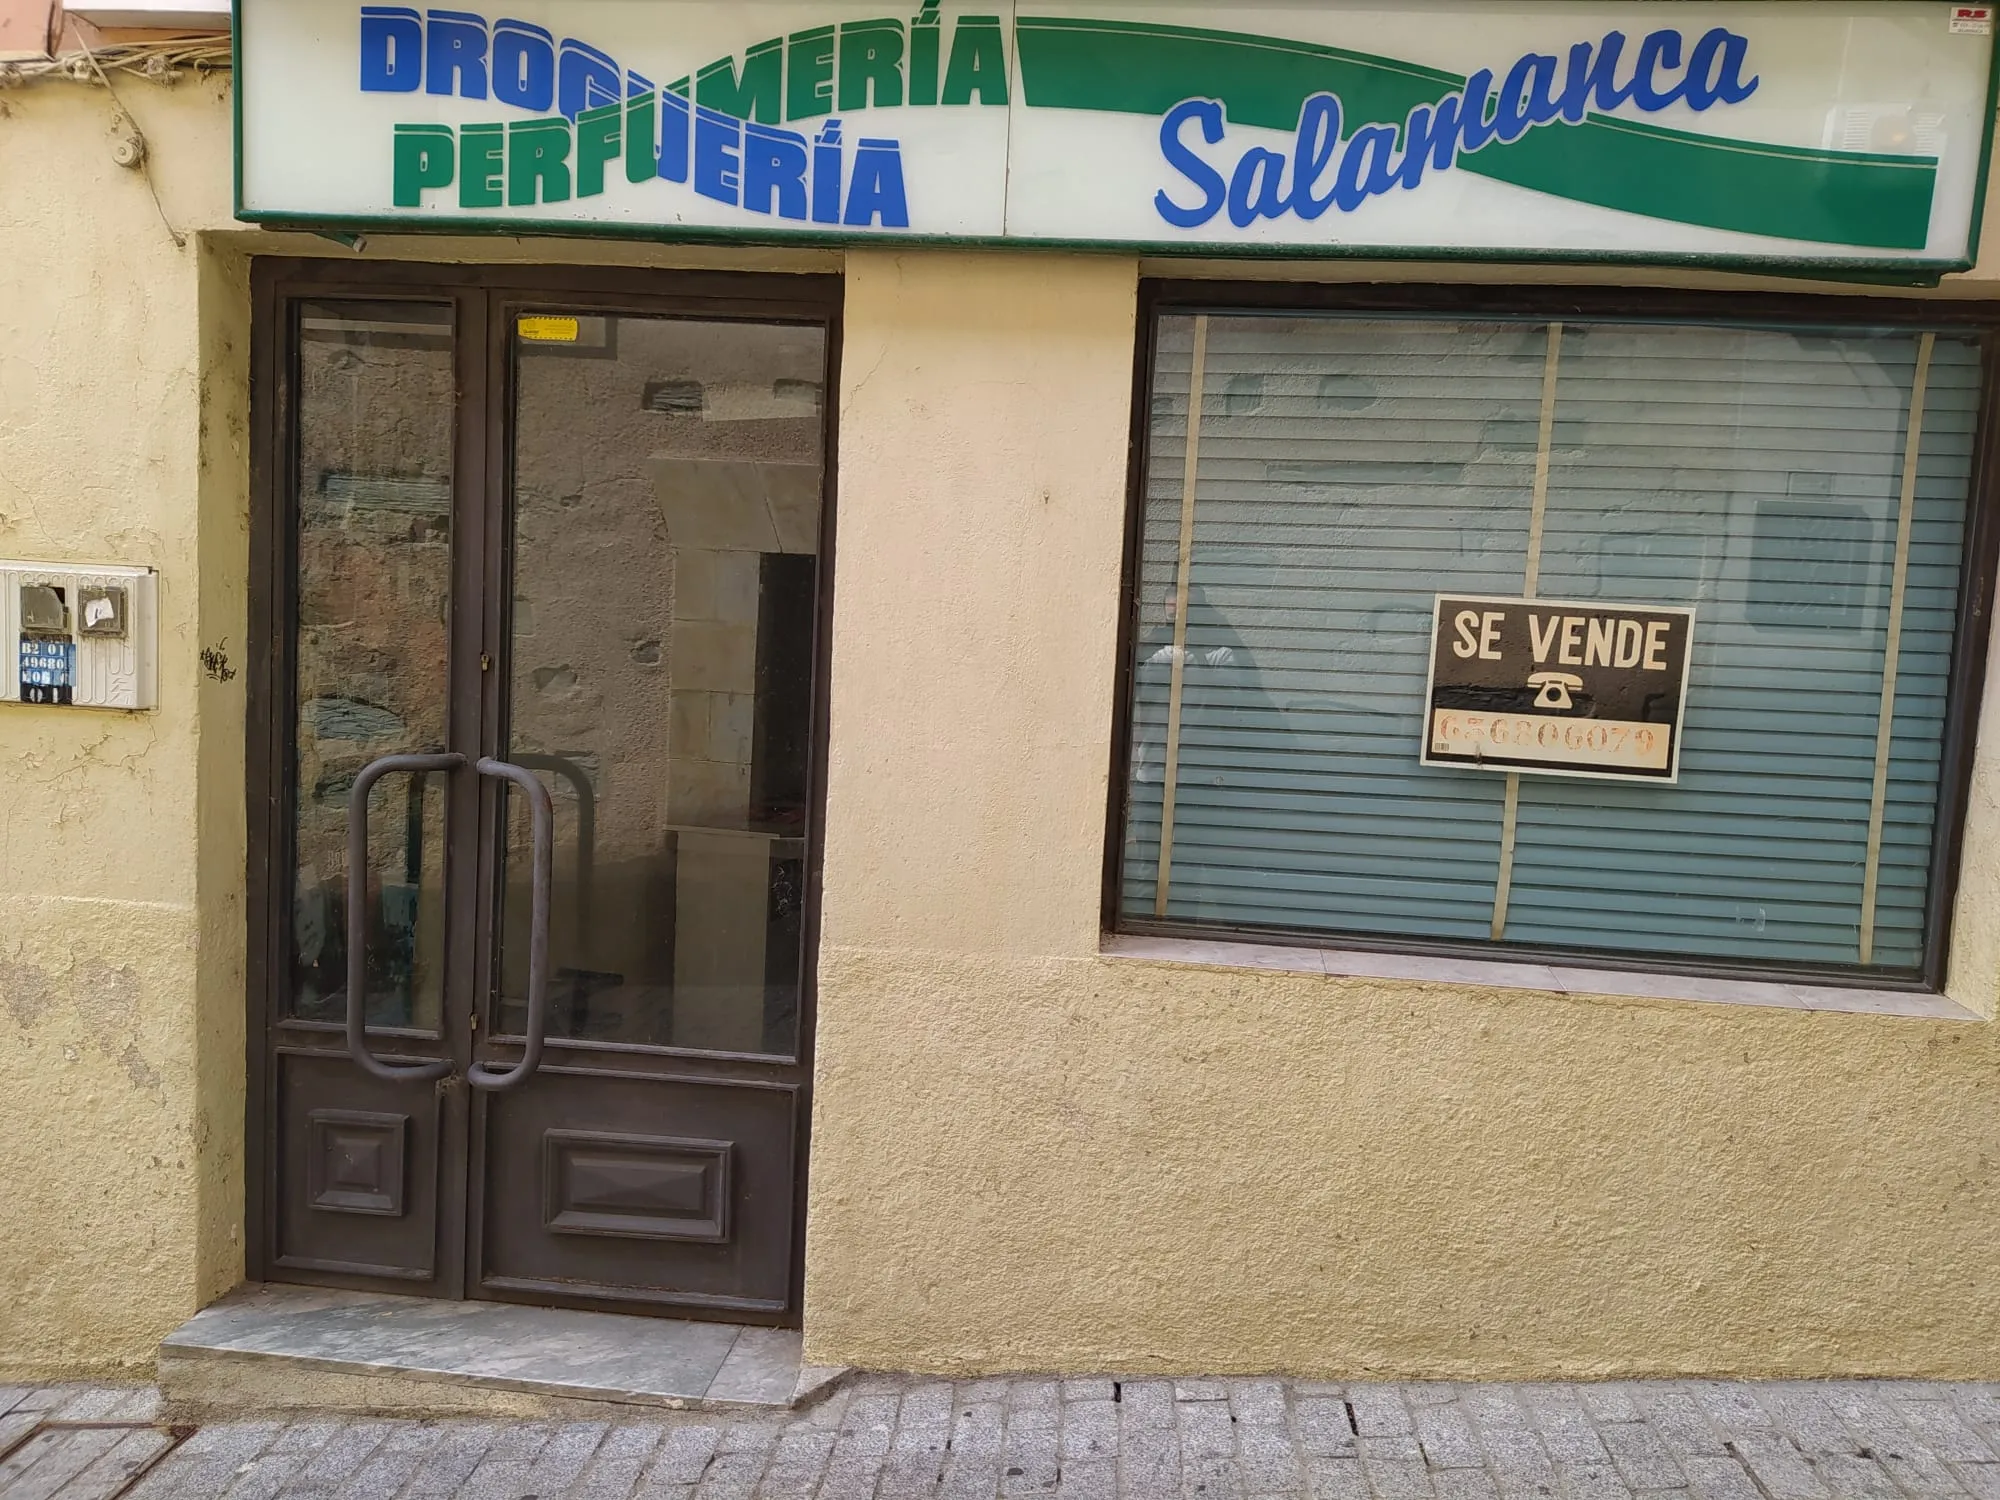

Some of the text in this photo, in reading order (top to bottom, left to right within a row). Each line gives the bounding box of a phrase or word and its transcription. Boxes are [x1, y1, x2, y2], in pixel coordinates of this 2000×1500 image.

[360, 6, 909, 227] DROGUERÍA
[393, 0, 1009, 207] PERFUMERÍA
[1154, 27, 1760, 229] Salamanca
[1453, 610, 1671, 671] SE VENDE
